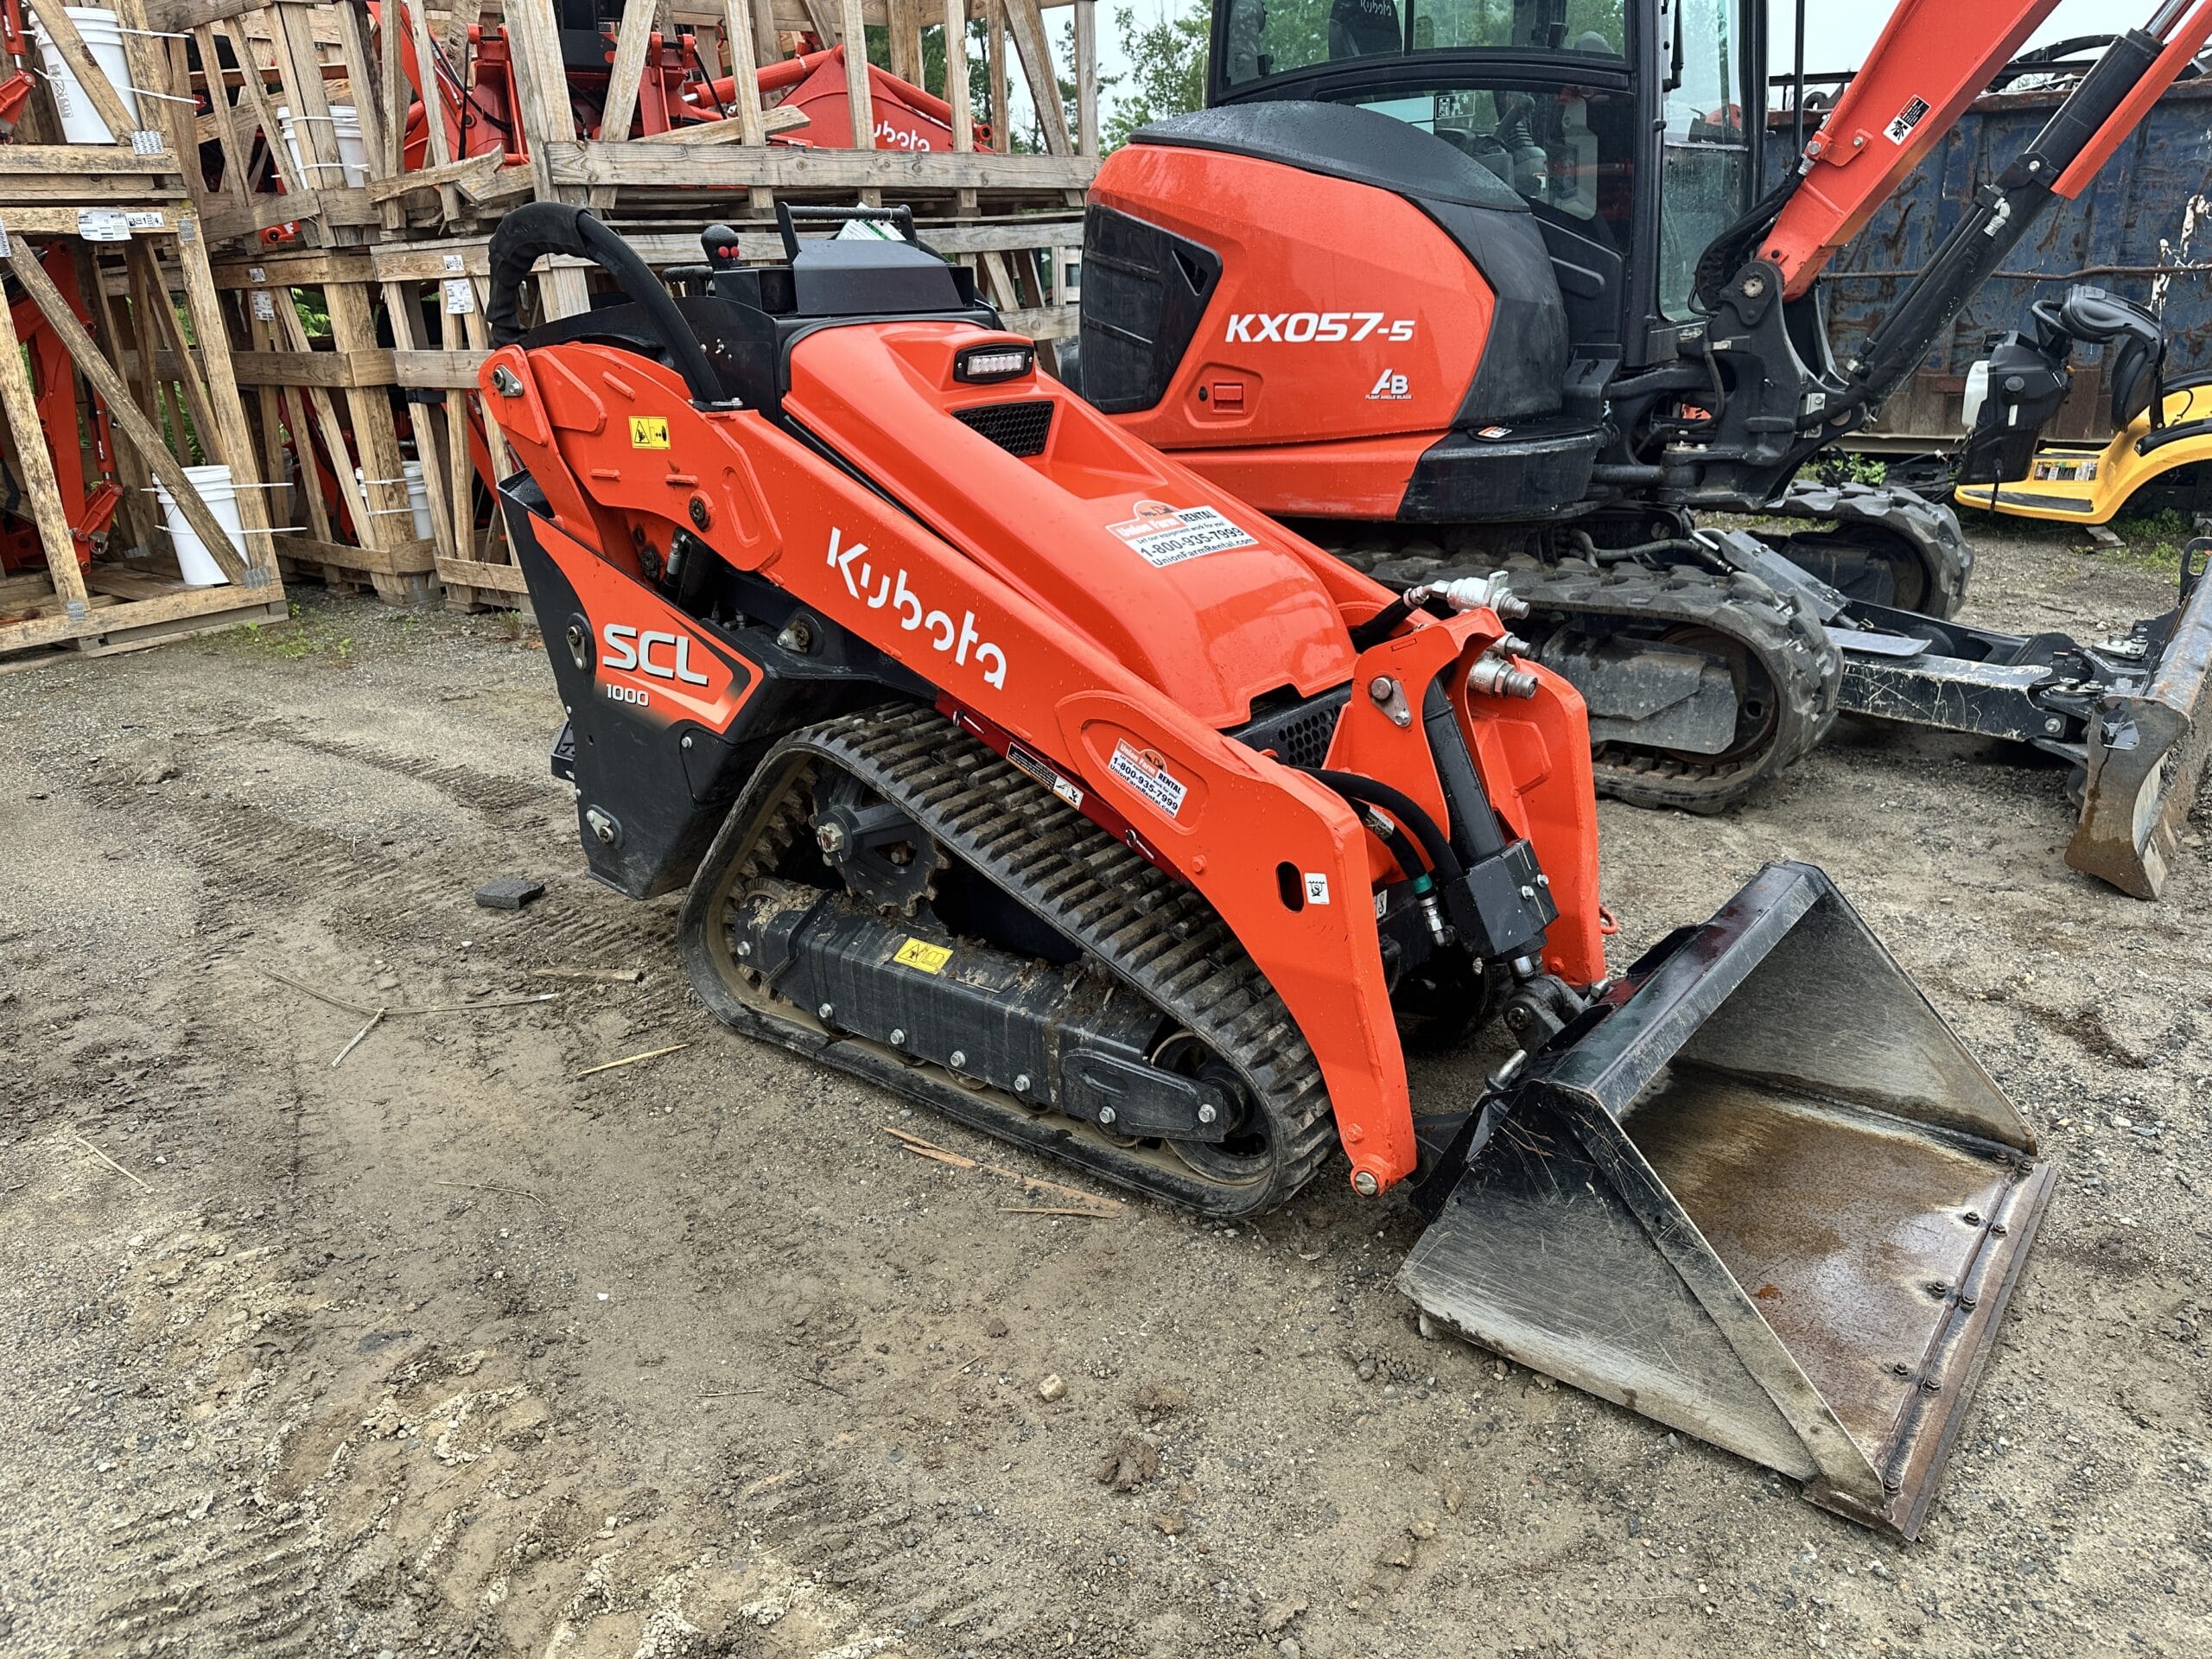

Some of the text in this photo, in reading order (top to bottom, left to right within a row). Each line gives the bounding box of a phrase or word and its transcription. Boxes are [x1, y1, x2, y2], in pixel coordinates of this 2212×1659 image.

[1360, 0, 1391, 16] Kubota
[874, 120, 930, 152] ubota
[1225, 312, 1415, 342] KX057-5
[1116, 510, 1217, 537] Union Farm RENTAL
[1140, 527, 1244, 557] 1-800-935-7999
[1152, 537, 1255, 566] UnionFarmRental.com
[827, 526, 1007, 690] Kubota
[602, 623, 709, 688] SCL
[606, 683, 649, 707] 1000
[1113, 757, 1179, 810] 1-800-935-7999
[1119, 742, 1181, 795] Union Farm RENTAL
[1109, 764, 1175, 817] UnionFarmRental.com
